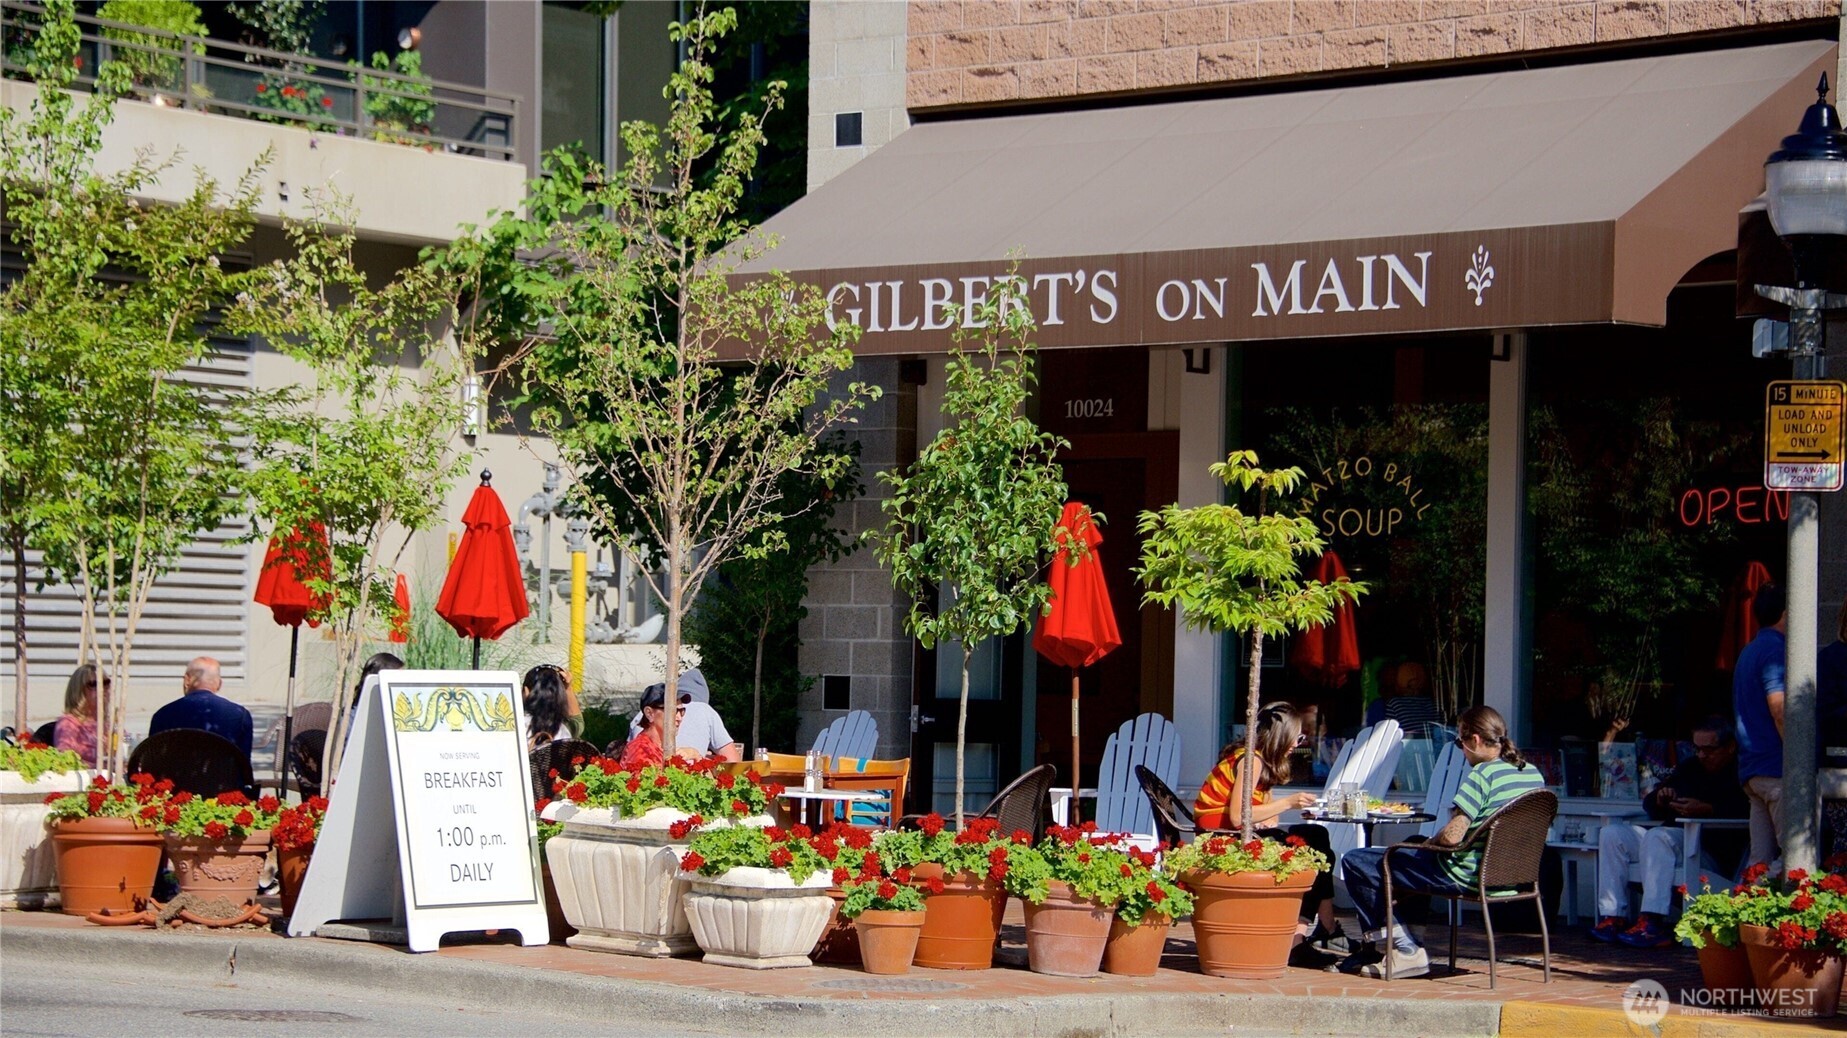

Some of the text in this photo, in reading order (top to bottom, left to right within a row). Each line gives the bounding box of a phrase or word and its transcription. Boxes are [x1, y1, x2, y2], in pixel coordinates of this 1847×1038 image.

[824, 251, 1433, 334] GILBERT'S ON MAIN
[1774, 386, 1787, 401] 15
[1064, 398, 1114, 418] 10024
[1778, 409, 1833, 420] LOAD AND
[1783, 423, 1827, 434] UNLOAD
[1791, 437, 1818, 448] ONLY
[1778, 466, 1829, 474] TOW-AWAY
[1790, 475, 1817, 484] ZONE
[1294, 456, 1432, 521] MATZO BALL
[1681, 486, 1790, 526] OPEN
[1322, 507, 1403, 537] SOUP
[439, 752, 480, 760] NOW SERVING
[424, 771, 504, 789] BREAKFAST
[453, 804, 477, 815] UNTIL
[436, 826, 507, 850] 1:00 p.m.
[450, 862, 494, 883] DAILY
